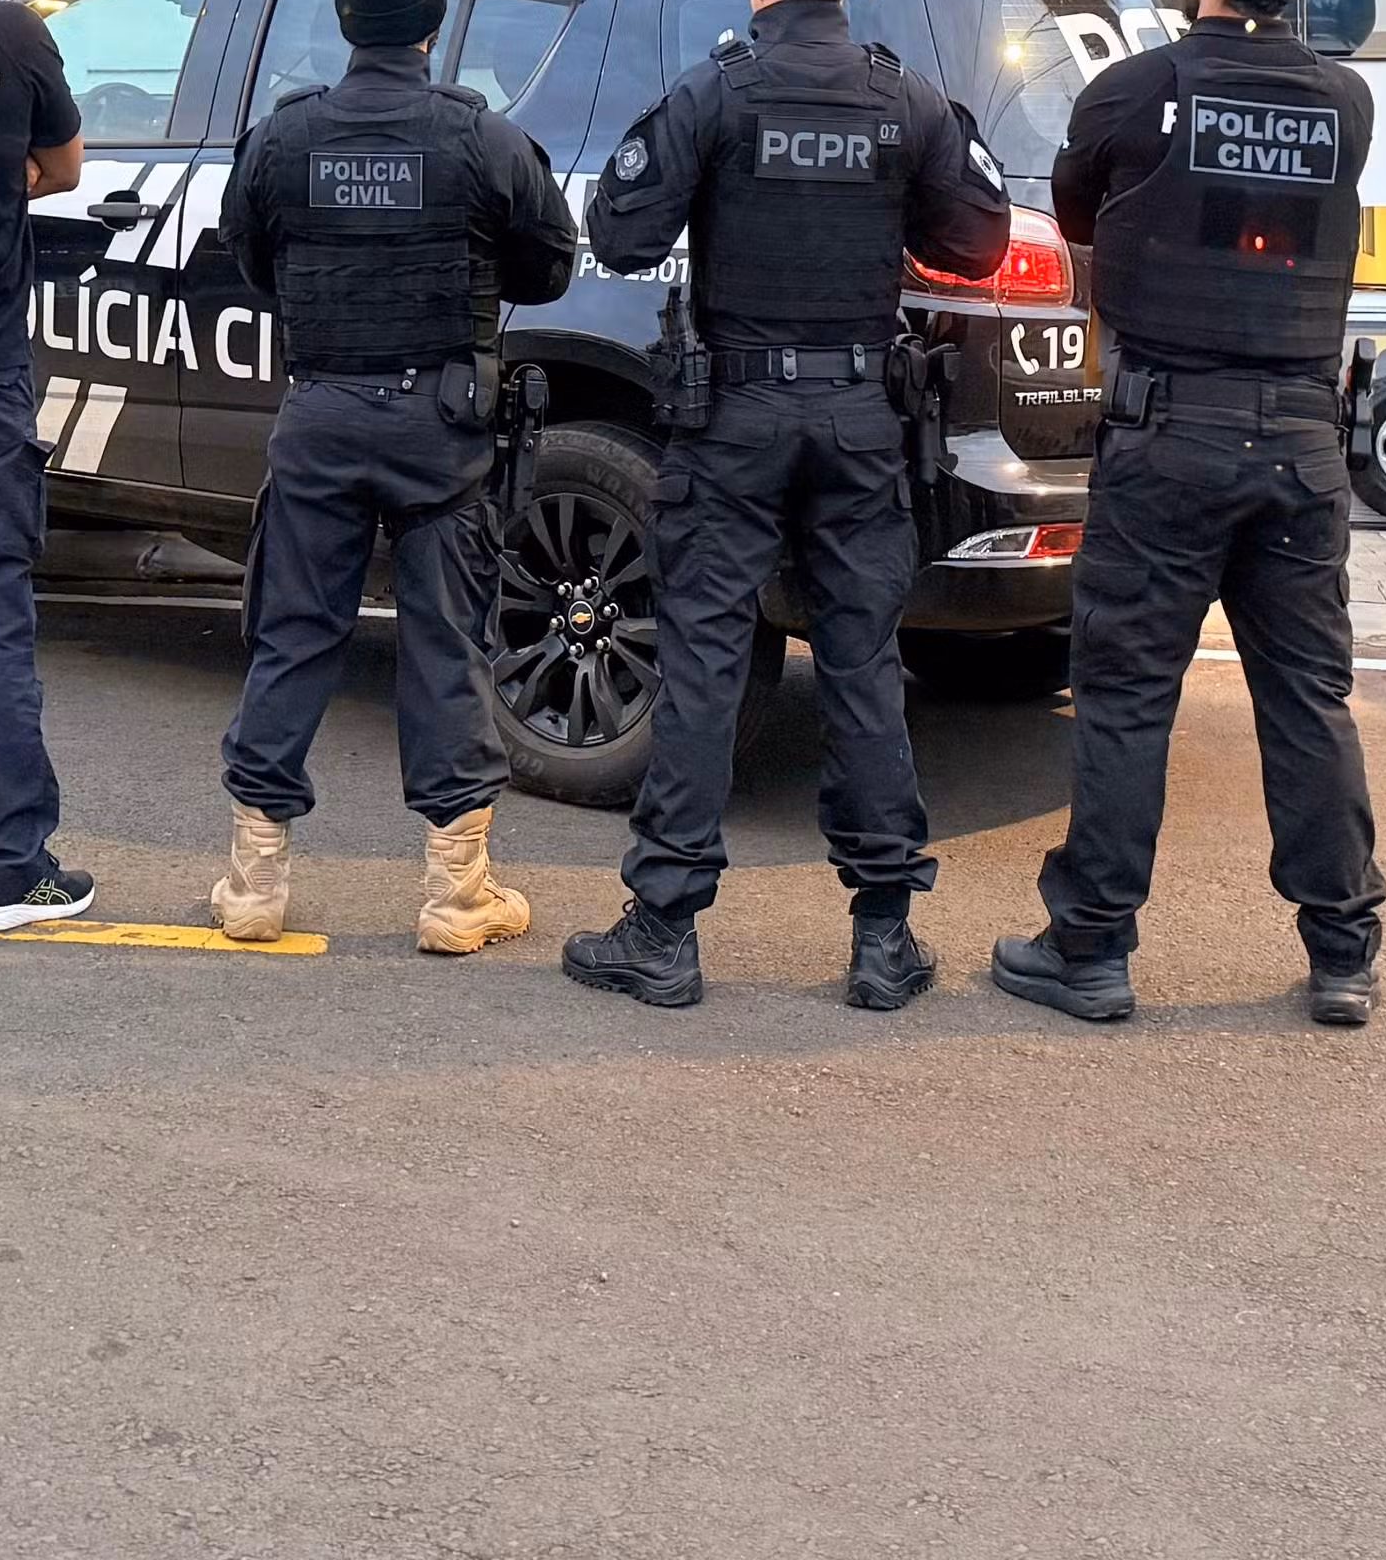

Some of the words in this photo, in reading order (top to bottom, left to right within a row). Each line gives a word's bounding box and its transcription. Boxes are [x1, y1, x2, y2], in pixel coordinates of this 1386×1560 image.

[879, 124, 900, 140] 07
[1196, 107, 1334, 147] POLÍCIA
[761, 129, 872, 169] PCPR
[1217, 142, 1313, 176] CIVIL
[319, 157, 413, 182] POLÍCIA
[334, 184, 396, 206] CIVIL
